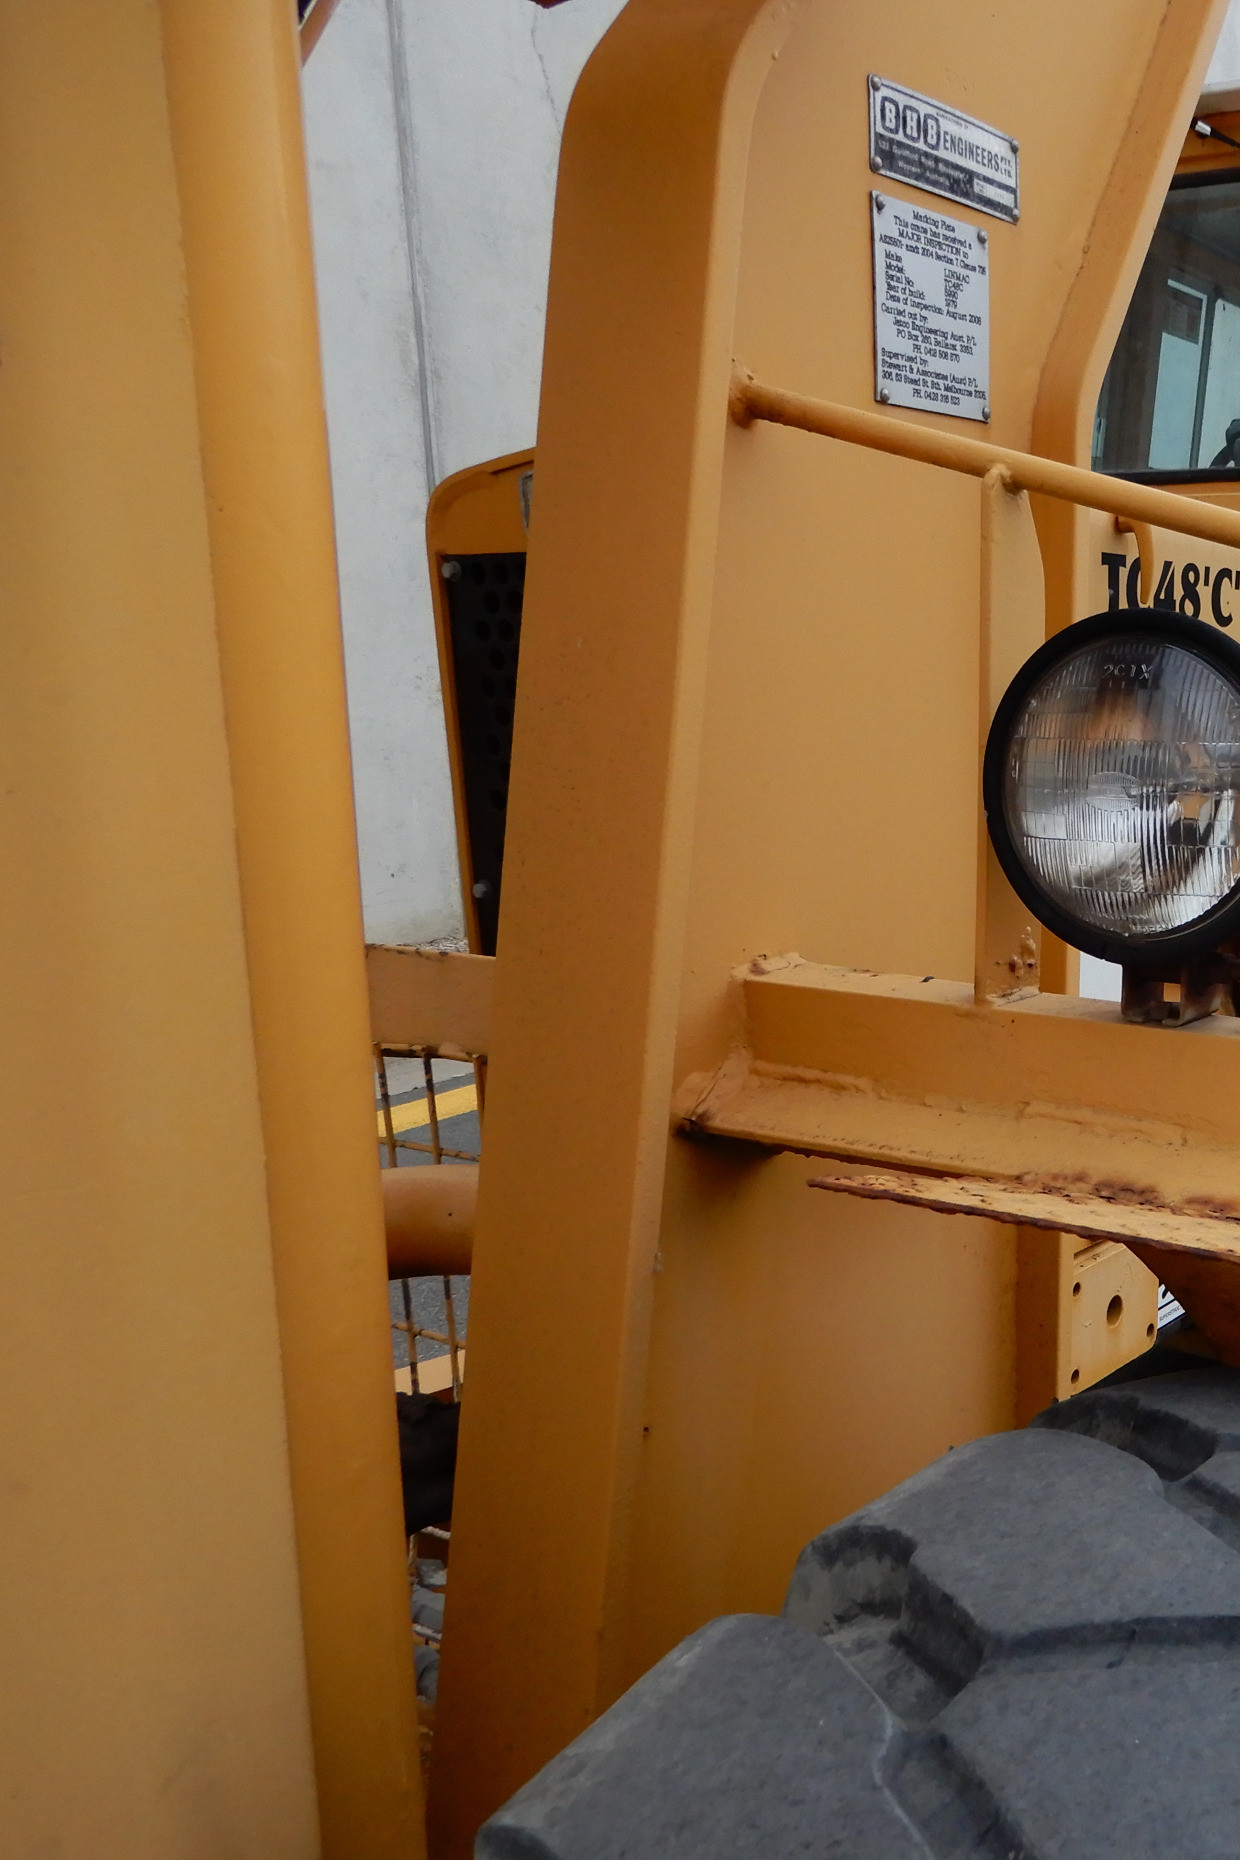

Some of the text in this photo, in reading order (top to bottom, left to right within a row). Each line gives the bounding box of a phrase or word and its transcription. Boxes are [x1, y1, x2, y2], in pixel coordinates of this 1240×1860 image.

[880, 96, 999, 172] BHB ENGINEERS
[913, 211, 939, 229] Marking
[894, 216, 909, 229] This
[910, 222, 928, 235] crane
[930, 228, 940, 239] has
[942, 232, 967, 248] received
[898, 228, 968, 259] MAJOR INSPECTION to
[935, 252, 954, 265] Section
[885, 271, 903, 284] Serial
[886, 281, 899, 293] Year
[901, 286, 907, 296] of
[881, 303, 906, 318] Carried
[908, 311, 918, 321] out
[886, 291, 901, 304] Date
[902, 296, 909, 306] of
[946, 308, 968, 323] August
[897, 329, 906, 339] PO
[907, 331, 920, 342] Box
[912, 321, 948, 341] Engineering
[881, 348, 918, 366] Supervised
[882, 359, 907, 373] Stewart
[909, 365, 914, 374] &
[916, 367, 948, 382] Associates
[904, 375, 921, 387] Stead
[943, 383, 973, 398] Melbourne
